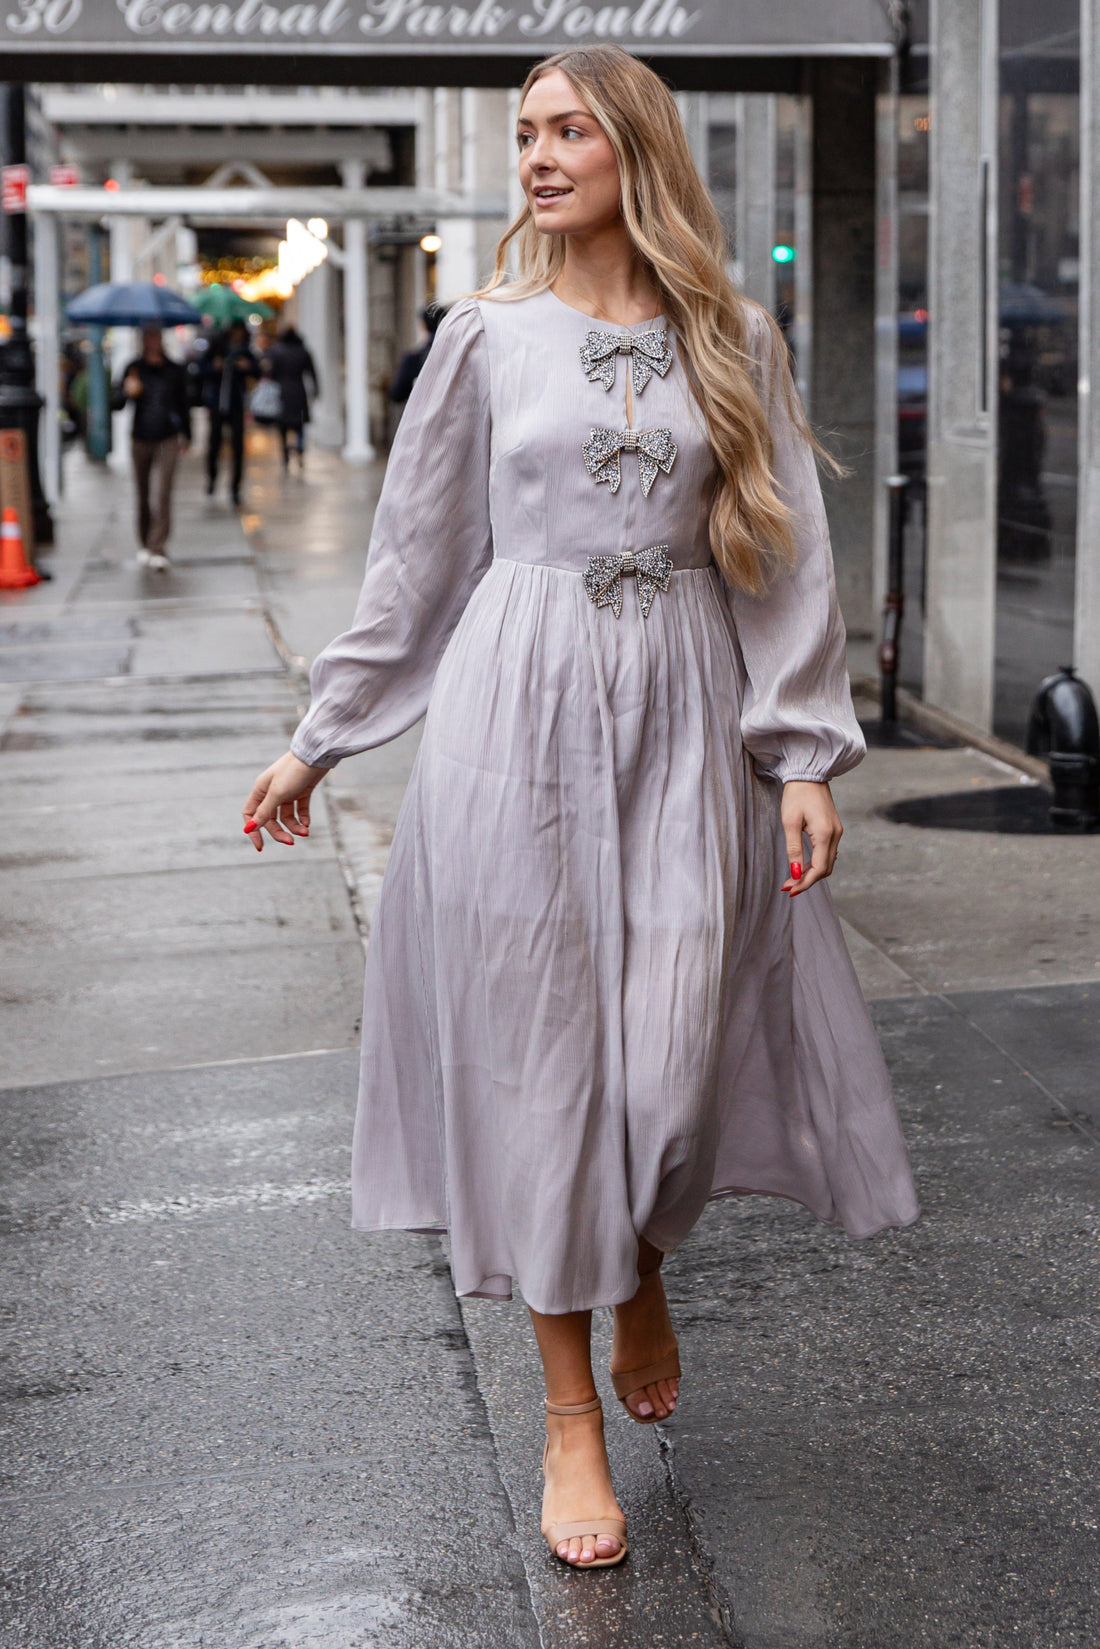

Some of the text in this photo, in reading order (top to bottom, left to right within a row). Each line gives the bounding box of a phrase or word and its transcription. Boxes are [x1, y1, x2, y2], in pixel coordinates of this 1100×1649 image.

[6, 0, 82, 34] 30
[116, 0, 350, 35] Central
[358, 0, 511, 37] Park
